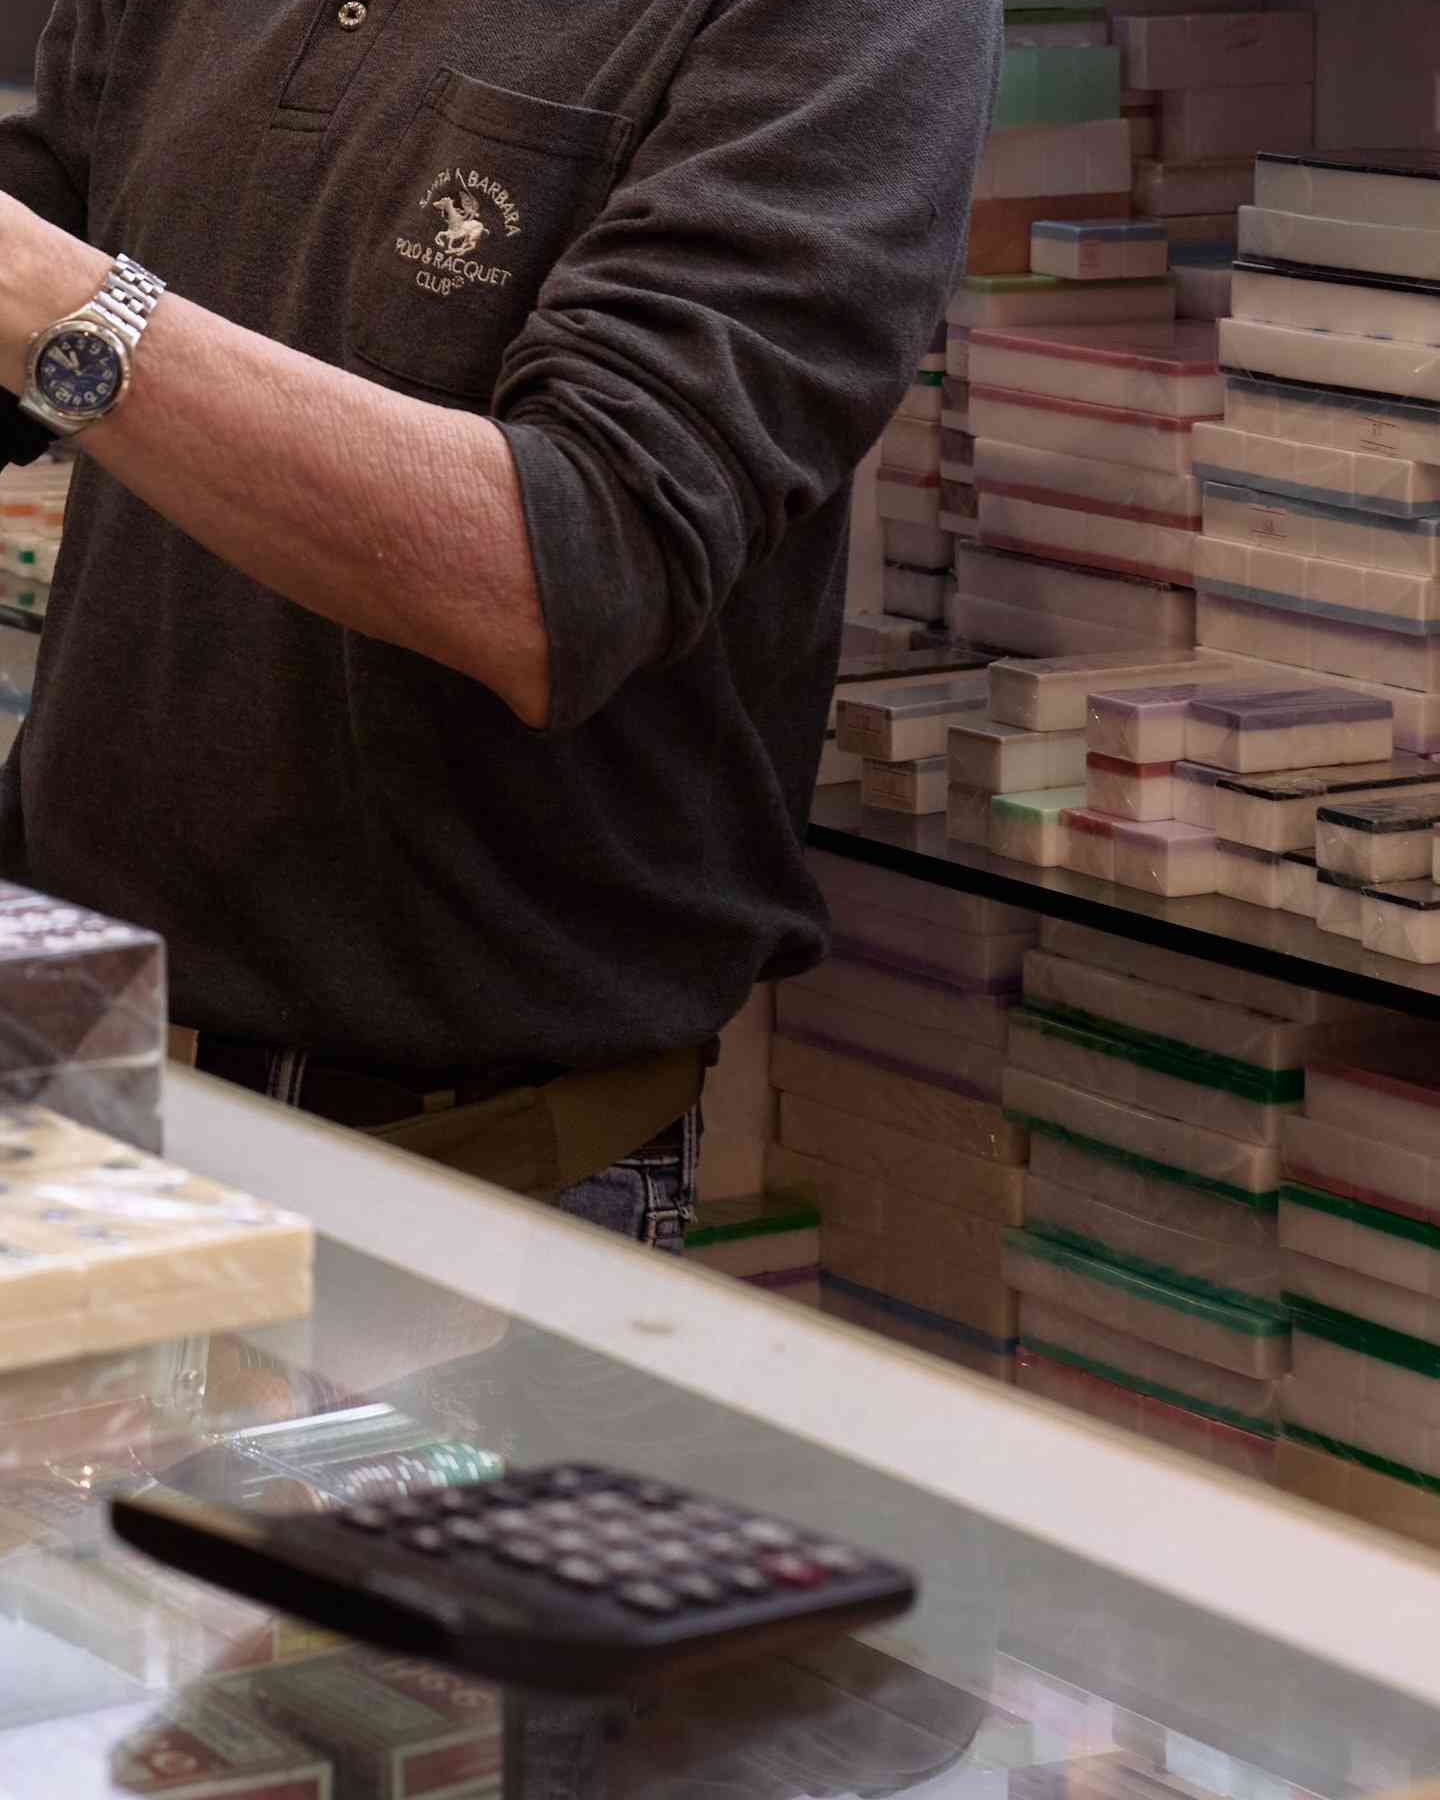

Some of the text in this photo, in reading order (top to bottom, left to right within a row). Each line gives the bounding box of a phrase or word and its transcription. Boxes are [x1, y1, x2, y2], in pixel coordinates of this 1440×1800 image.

[467, 170, 522, 237] BARBARA
[421, 247, 433, 264] &
[432, 250, 512, 285] RACQUET
